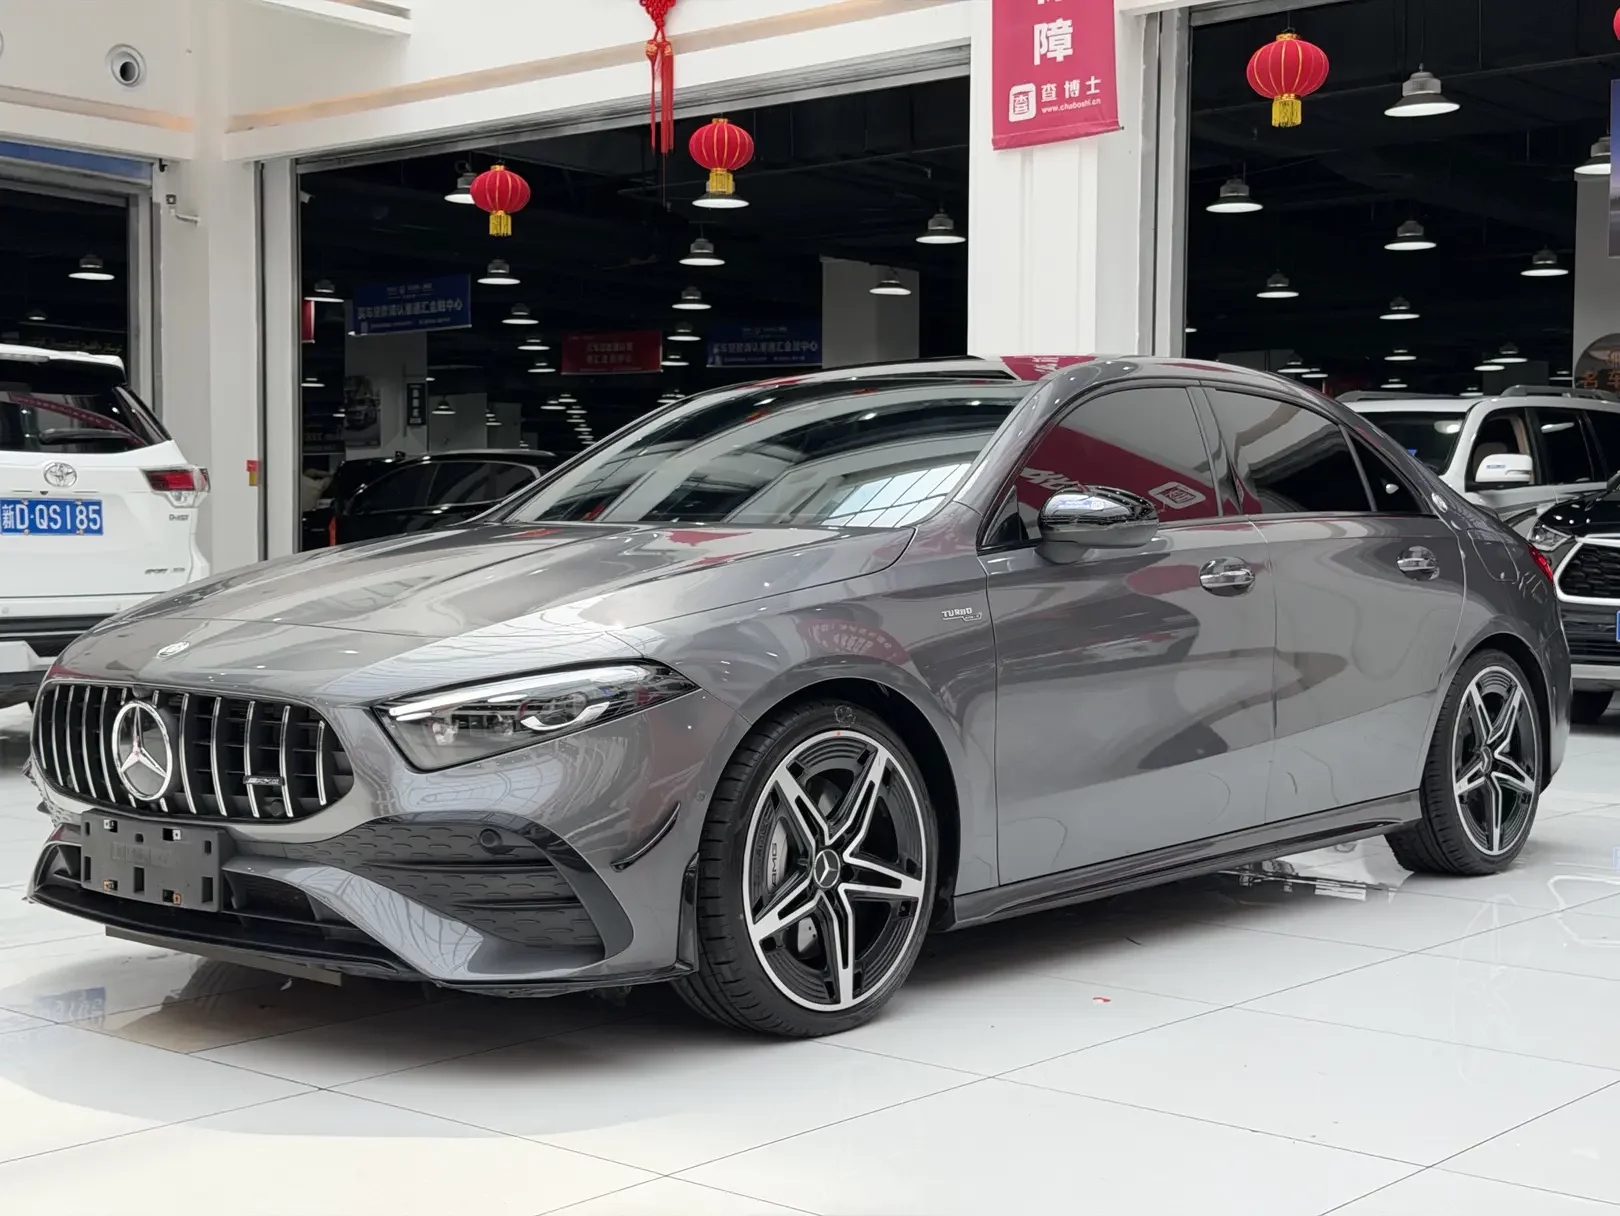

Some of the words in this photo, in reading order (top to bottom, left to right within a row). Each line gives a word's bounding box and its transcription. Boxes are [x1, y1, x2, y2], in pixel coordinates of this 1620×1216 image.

[1033, 0, 1074, 66] 障
[1041, 76, 1101, 103] 查博士
[1041, 98, 1102, 114] www.chaboshi.cn
[942, 607, 973, 618] TURBO
